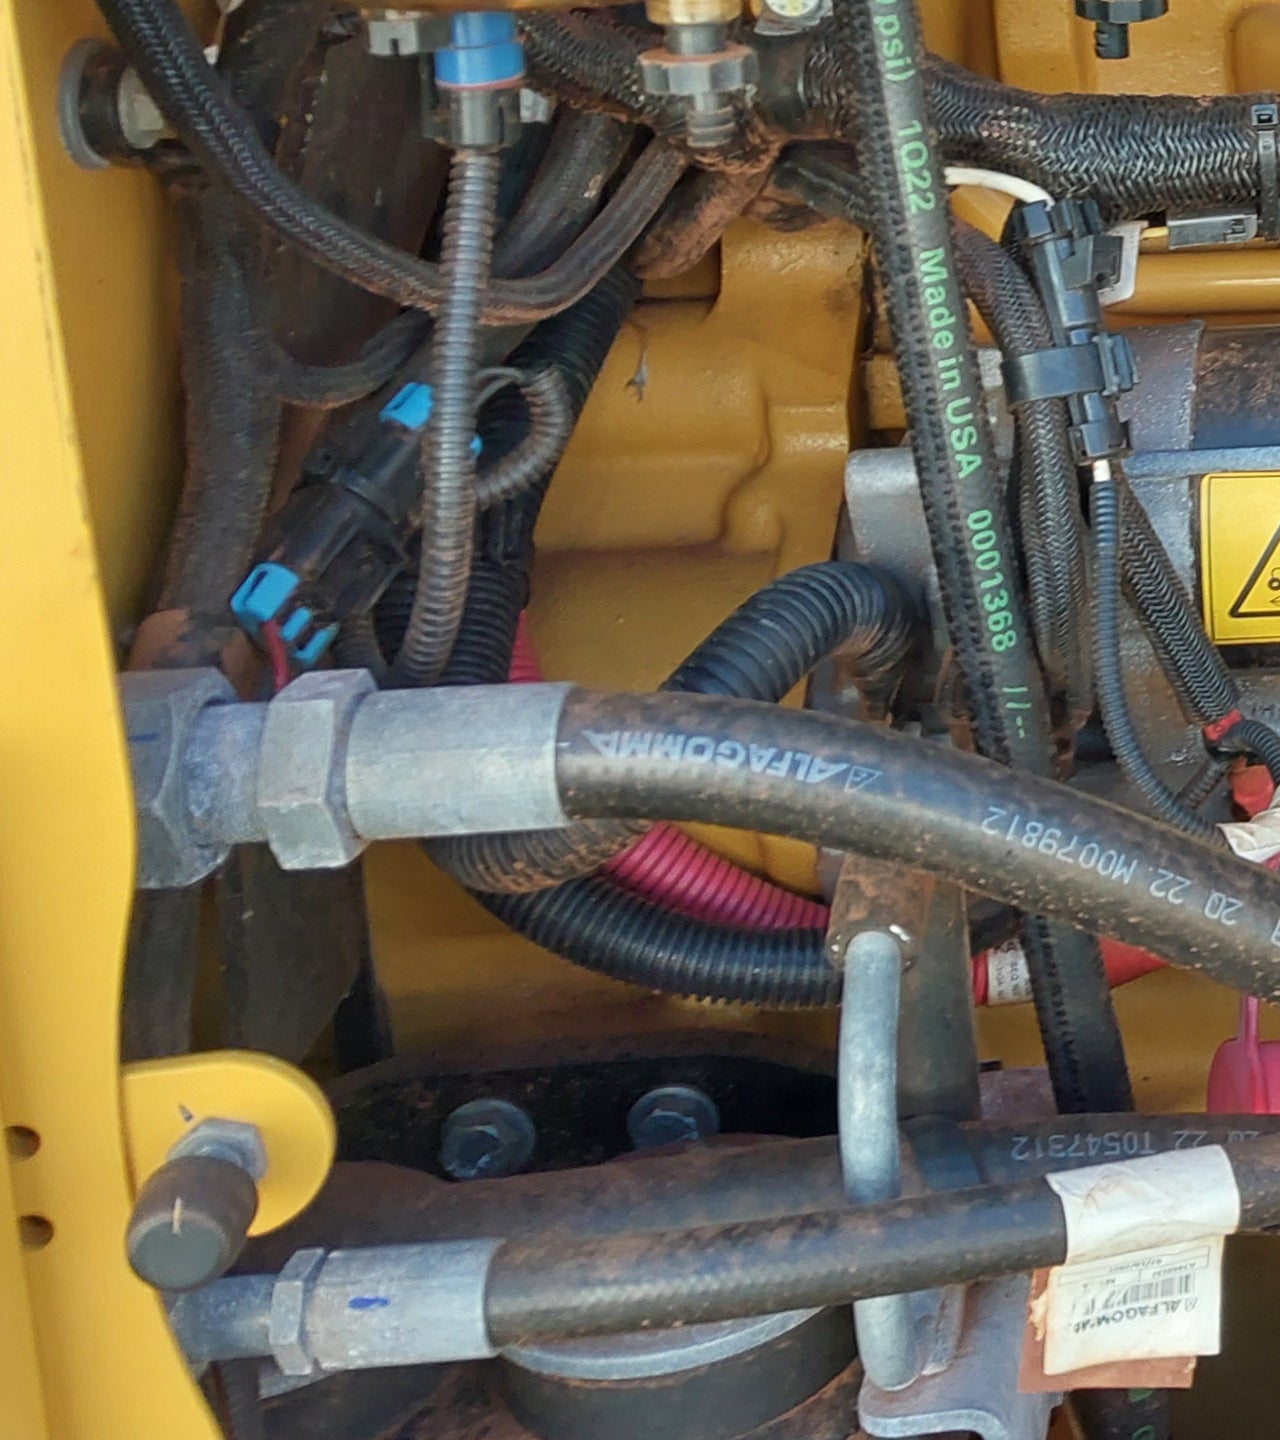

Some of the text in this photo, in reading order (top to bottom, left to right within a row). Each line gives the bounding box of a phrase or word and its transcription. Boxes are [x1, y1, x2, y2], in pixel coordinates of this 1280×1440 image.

[875, 14, 916, 83] psi)
[918, 247, 956, 350] Made
[937, 355, 963, 391] in
[945, 397, 983, 479] USA
[966, 509, 1017, 653] 0001368
[582, 728, 847, 785] ALFAGOMMA
[980, 803, 1140, 885] M0079812
